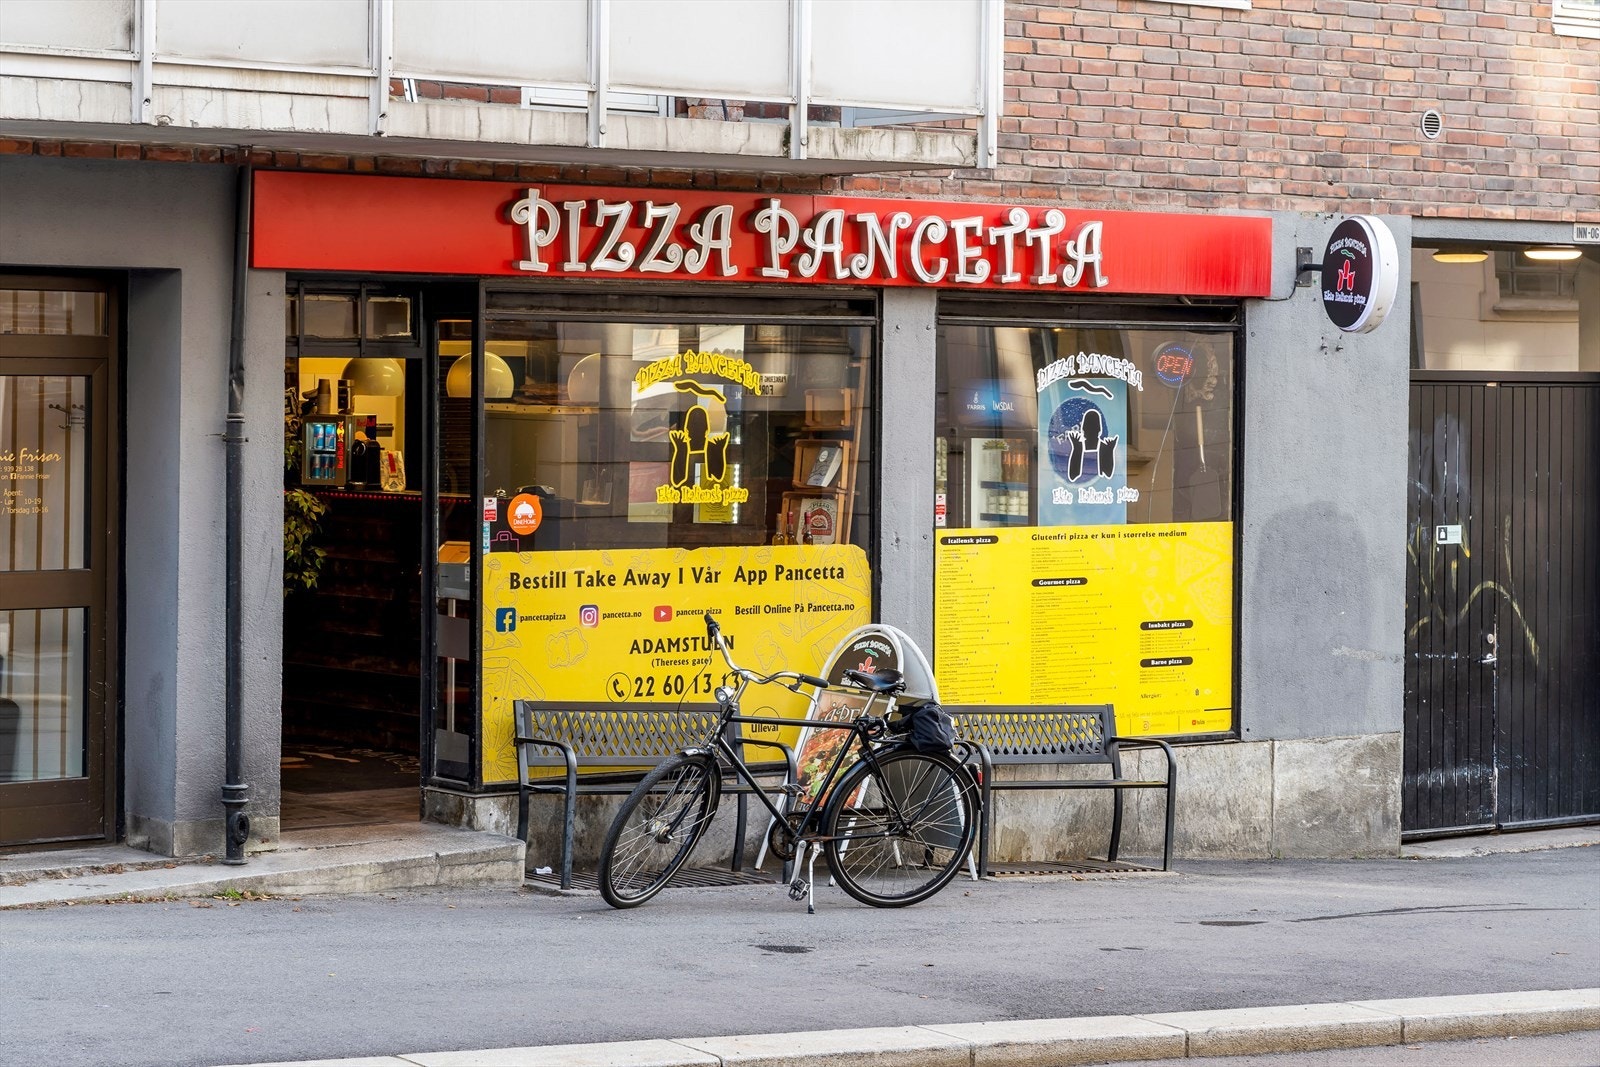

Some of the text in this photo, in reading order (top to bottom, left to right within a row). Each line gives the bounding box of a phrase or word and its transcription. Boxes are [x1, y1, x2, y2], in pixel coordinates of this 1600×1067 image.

[511, 188, 1109, 288] PIZZA PANCETTA
[1157, 355, 1193, 375] OPEN
[635, 349, 762, 396] PIZZA PANCETTA
[1037, 351, 1144, 392] PIZZA PANCETTA
[992, 400, 1015, 411] IMSDAL
[24, 497, 42, 505] 10-19
[31, 505, 49, 514] 10-16
[1031, 533, 1067, 541] Glutenfri
[1069, 532, 1089, 541] pizza
[1101, 531, 1116, 539] kun
[1123, 530, 1156, 539] størrelse
[1158, 529, 1188, 537] medium
[509, 570, 567, 590] Bestill
[573, 569, 617, 590] Take
[623, 567, 671, 589] Away
[691, 565, 722, 584] Vår
[733, 564, 769, 585] App
[774, 564, 846, 582] Pancetta
[1039, 578, 1081, 586] Gourmet pizza
[675, 608, 704, 617] pancetta
[734, 602, 856, 615] Bestill Online På Pancetta.no
[519, 612, 567, 623] pancettapizza
[602, 611, 642, 621] pancetta.no
[651, 656, 713, 668] (Thereses gate)
[1167, 658, 1183, 666] pizza
[634, 676, 655, 697] 22
[663, 674, 684, 696] 60
[693, 673, 712, 694] 13
[824, 702, 861, 723] ÅPE
